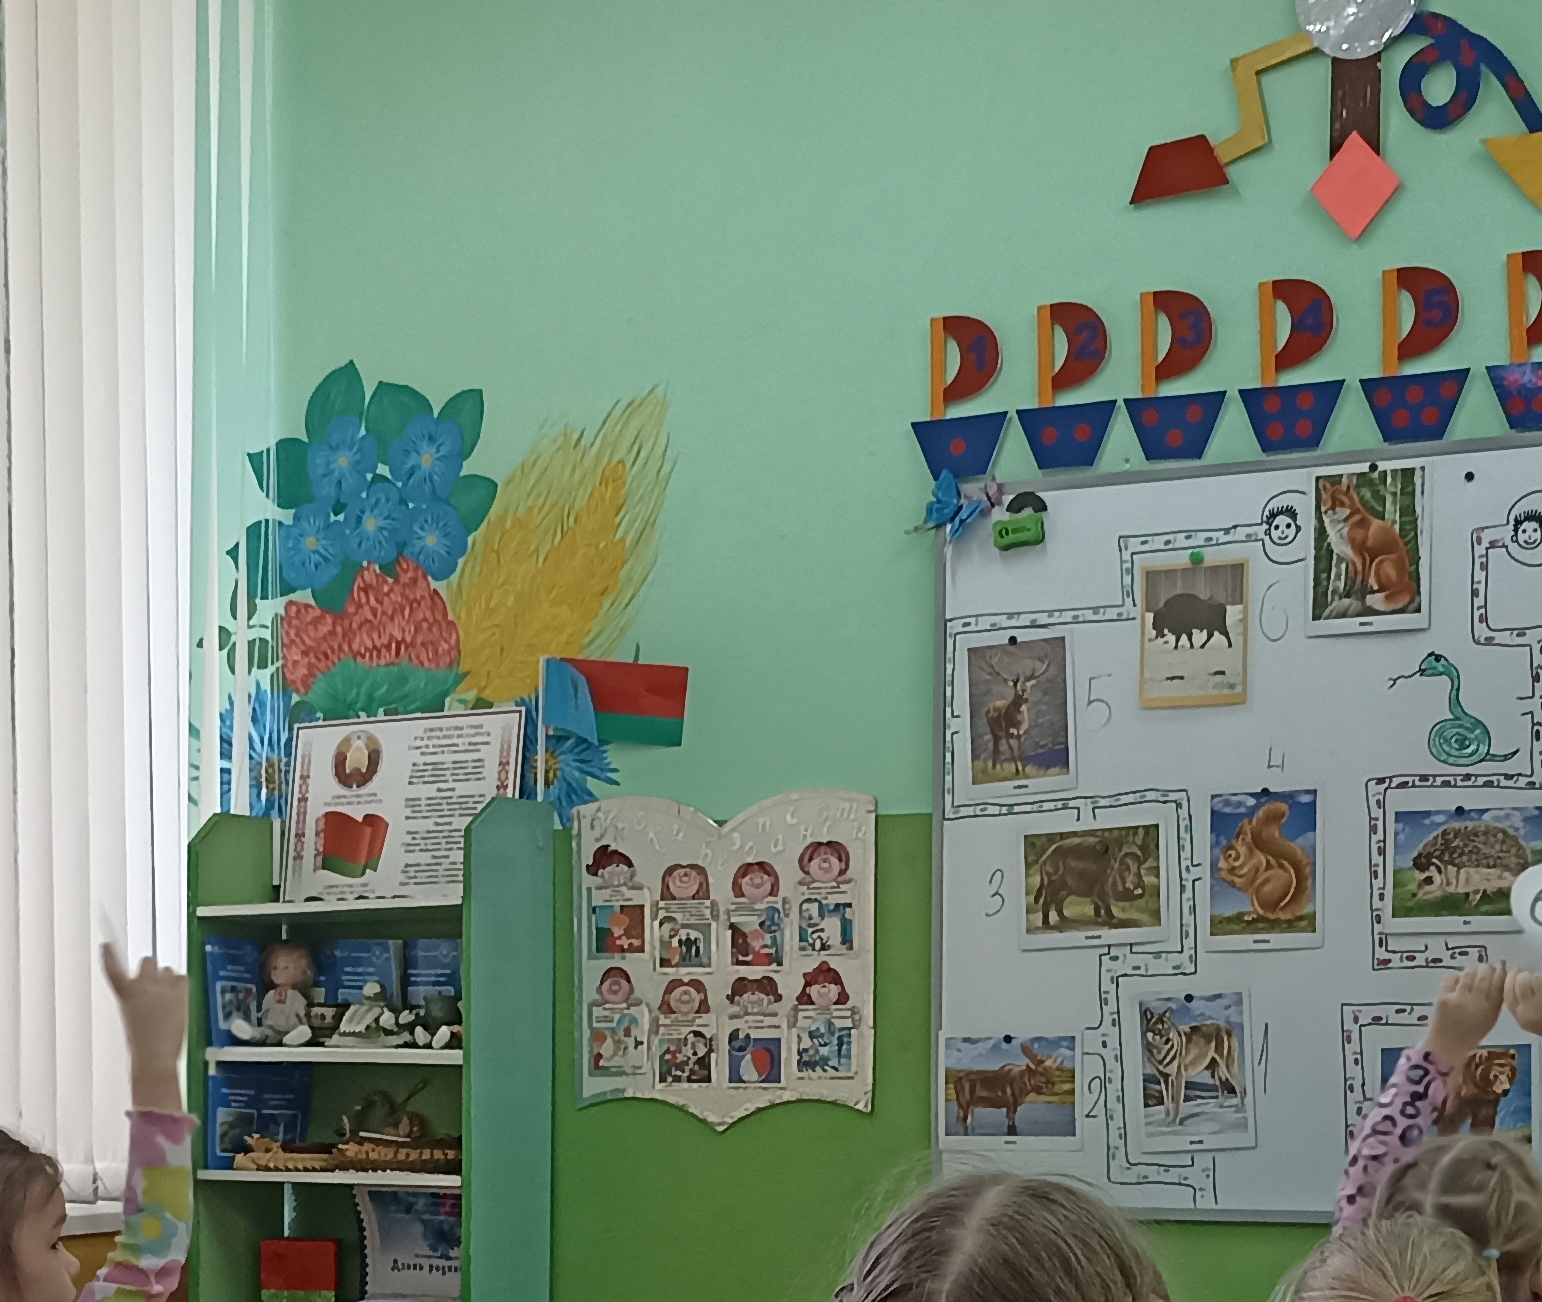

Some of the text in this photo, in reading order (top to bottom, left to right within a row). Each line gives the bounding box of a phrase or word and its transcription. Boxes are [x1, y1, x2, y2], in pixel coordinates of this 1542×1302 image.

[1176, 309, 1205, 349] 3
[1293, 299, 1326, 337] 4
[1420, 288, 1452, 329] 5
[966, 336, 987, 373] 1
[1073, 322, 1100, 361] 2
[1260, 580, 1289, 642] 6
[1085, 674, 1113, 733] 5
[985, 868, 1006, 918] 3
[1084, 1076, 1103, 1119] 2
